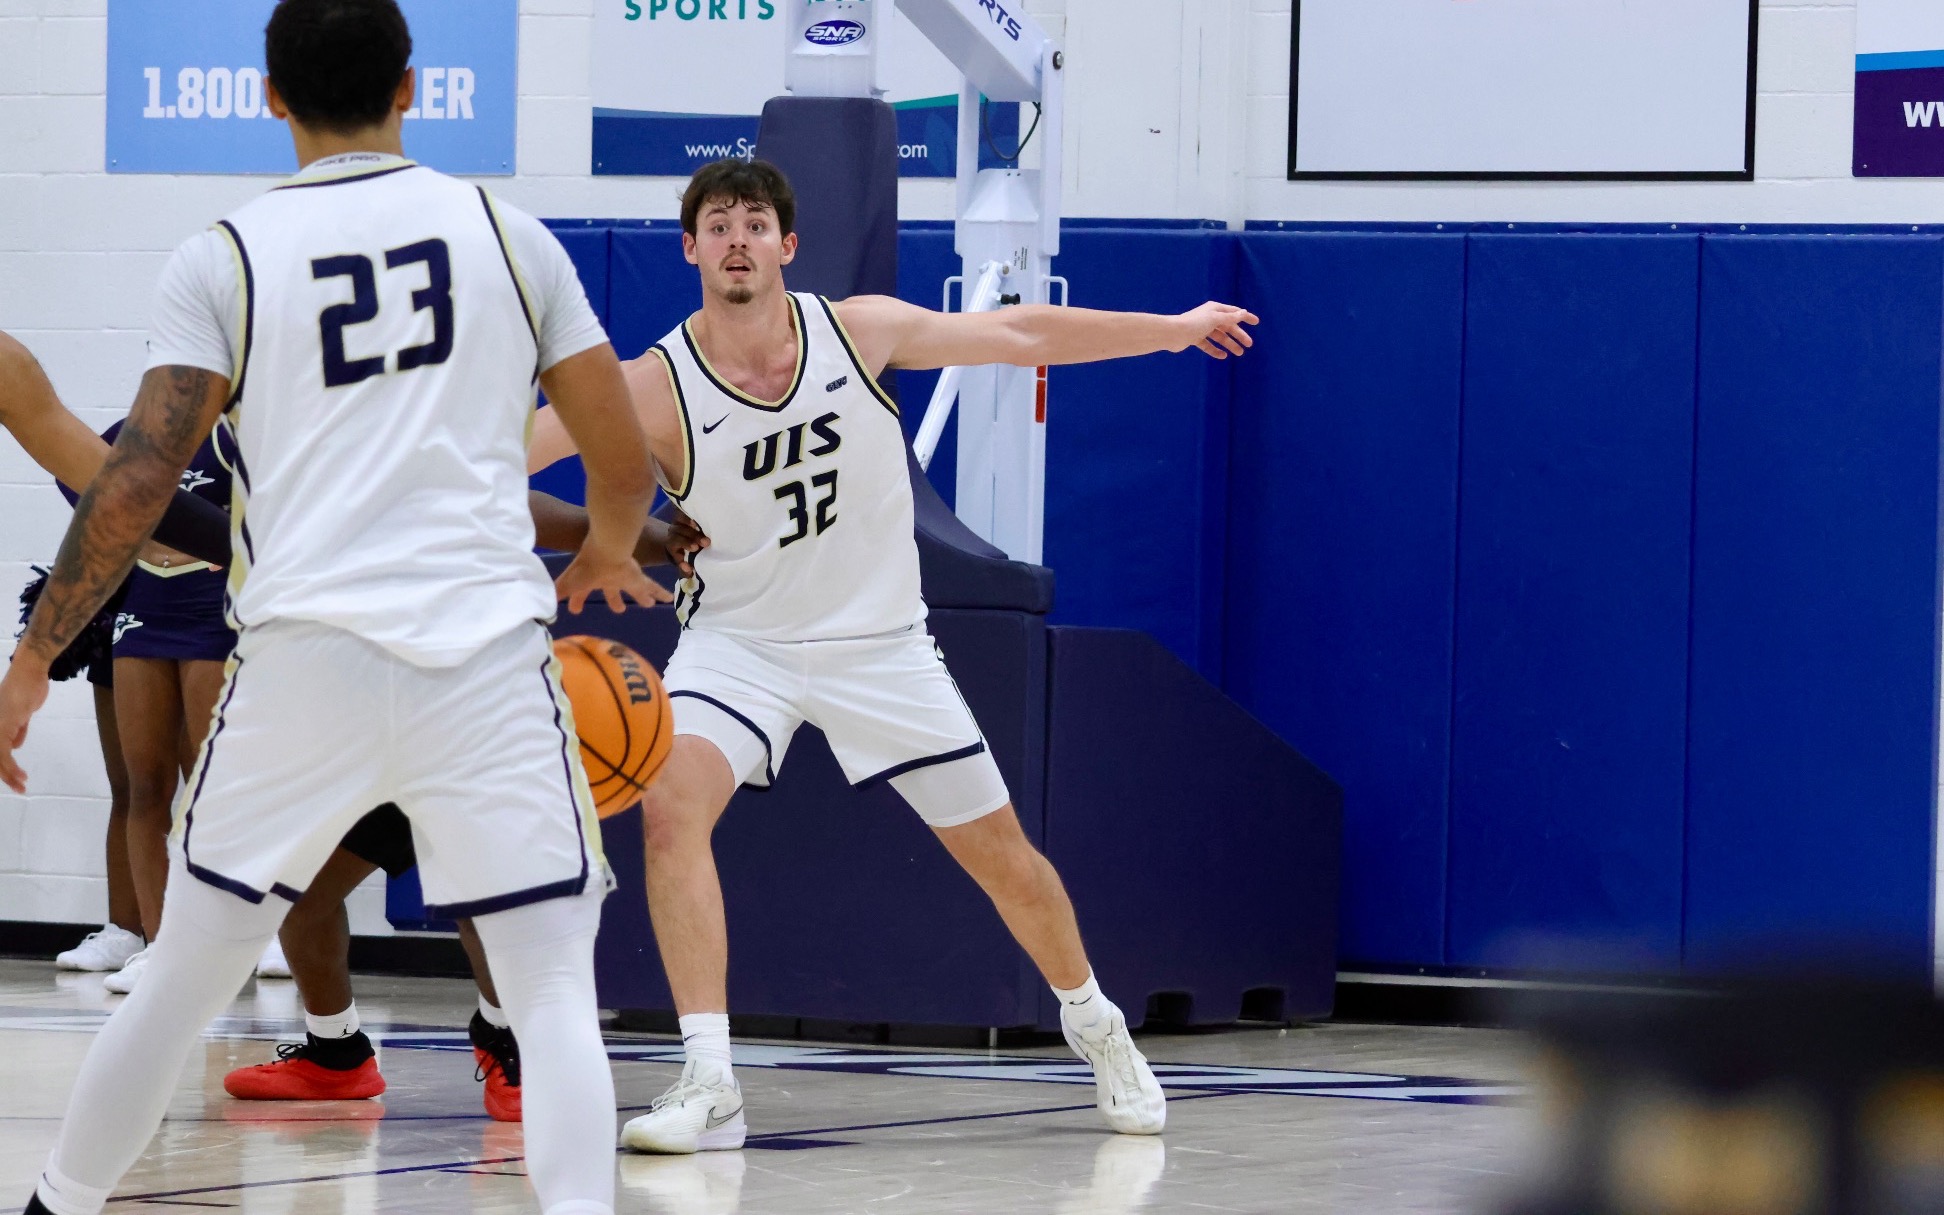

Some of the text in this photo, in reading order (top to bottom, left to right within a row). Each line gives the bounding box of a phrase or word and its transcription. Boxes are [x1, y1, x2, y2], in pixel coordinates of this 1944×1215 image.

[624, 0, 775, 21] SPORTS
[805, 25, 862, 38] SNA
[310, 238, 454, 388] 23
[742, 411, 842, 481] UIS
[773, 469, 839, 549] 32
